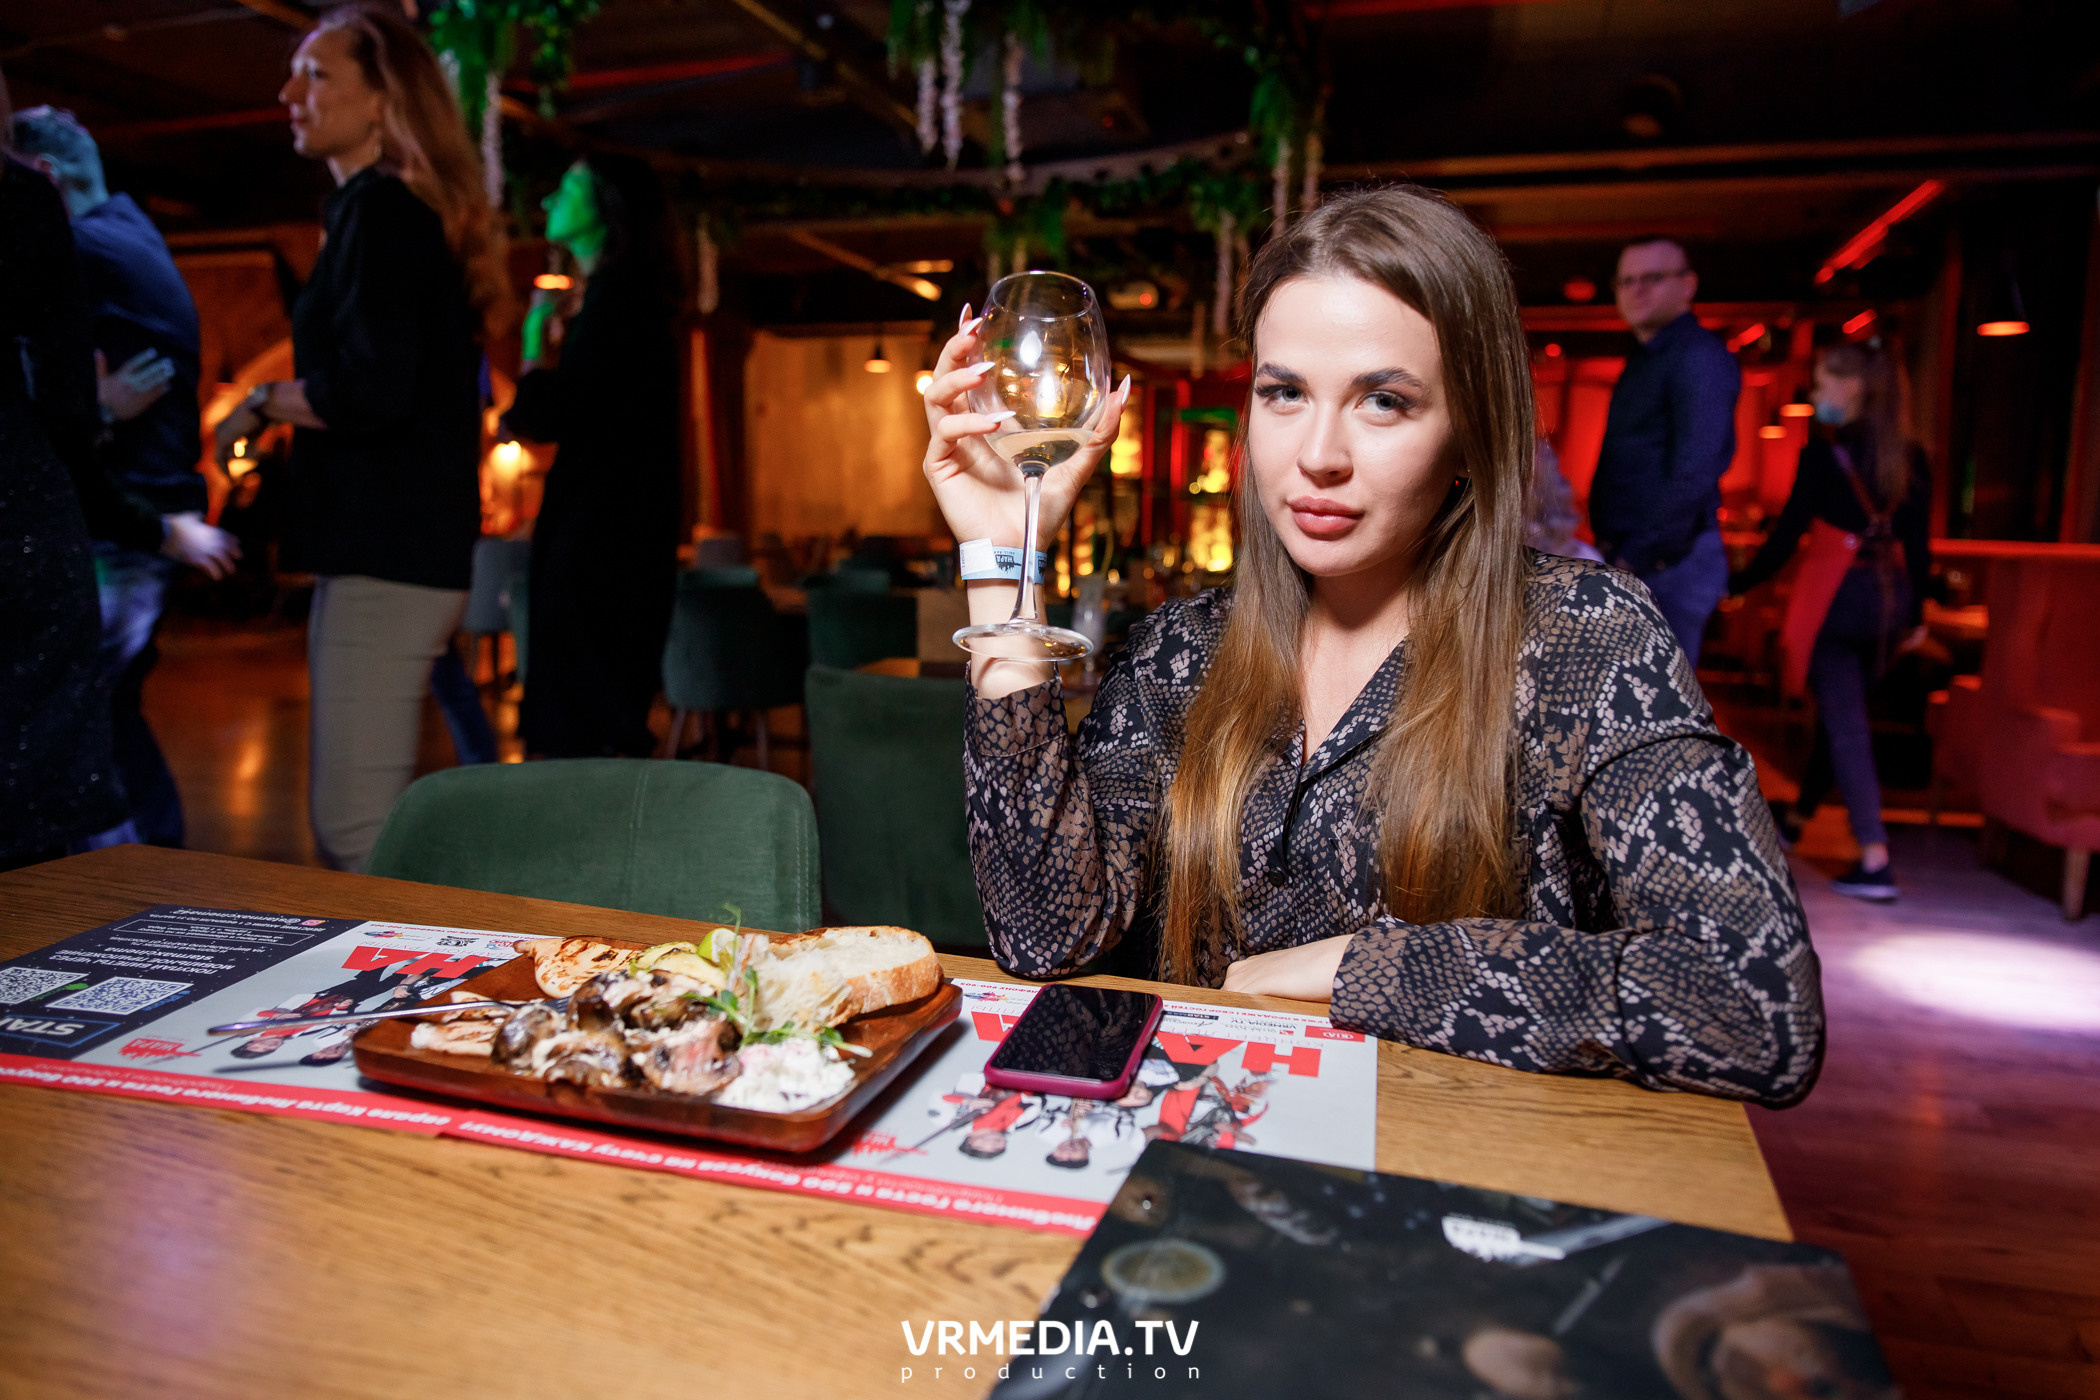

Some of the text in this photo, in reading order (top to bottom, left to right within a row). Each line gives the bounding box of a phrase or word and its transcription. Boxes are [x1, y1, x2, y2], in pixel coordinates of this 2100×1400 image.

[0, 1067, 63, 1082] бонус
[61, 1074, 106, 1087] 500
[120, 1081, 183, 1095] Гостя
[182, 1087, 298, 1109] Любимого
[294, 1100, 367, 1117] Карта
[366, 1107, 451, 1126] еврале
[698, 1161, 801, 1186] бонусов
[802, 1176, 853, 1195] 500
[875, 1187, 950, 1209] Гостя
[952, 1199, 1098, 1231] Любимого
